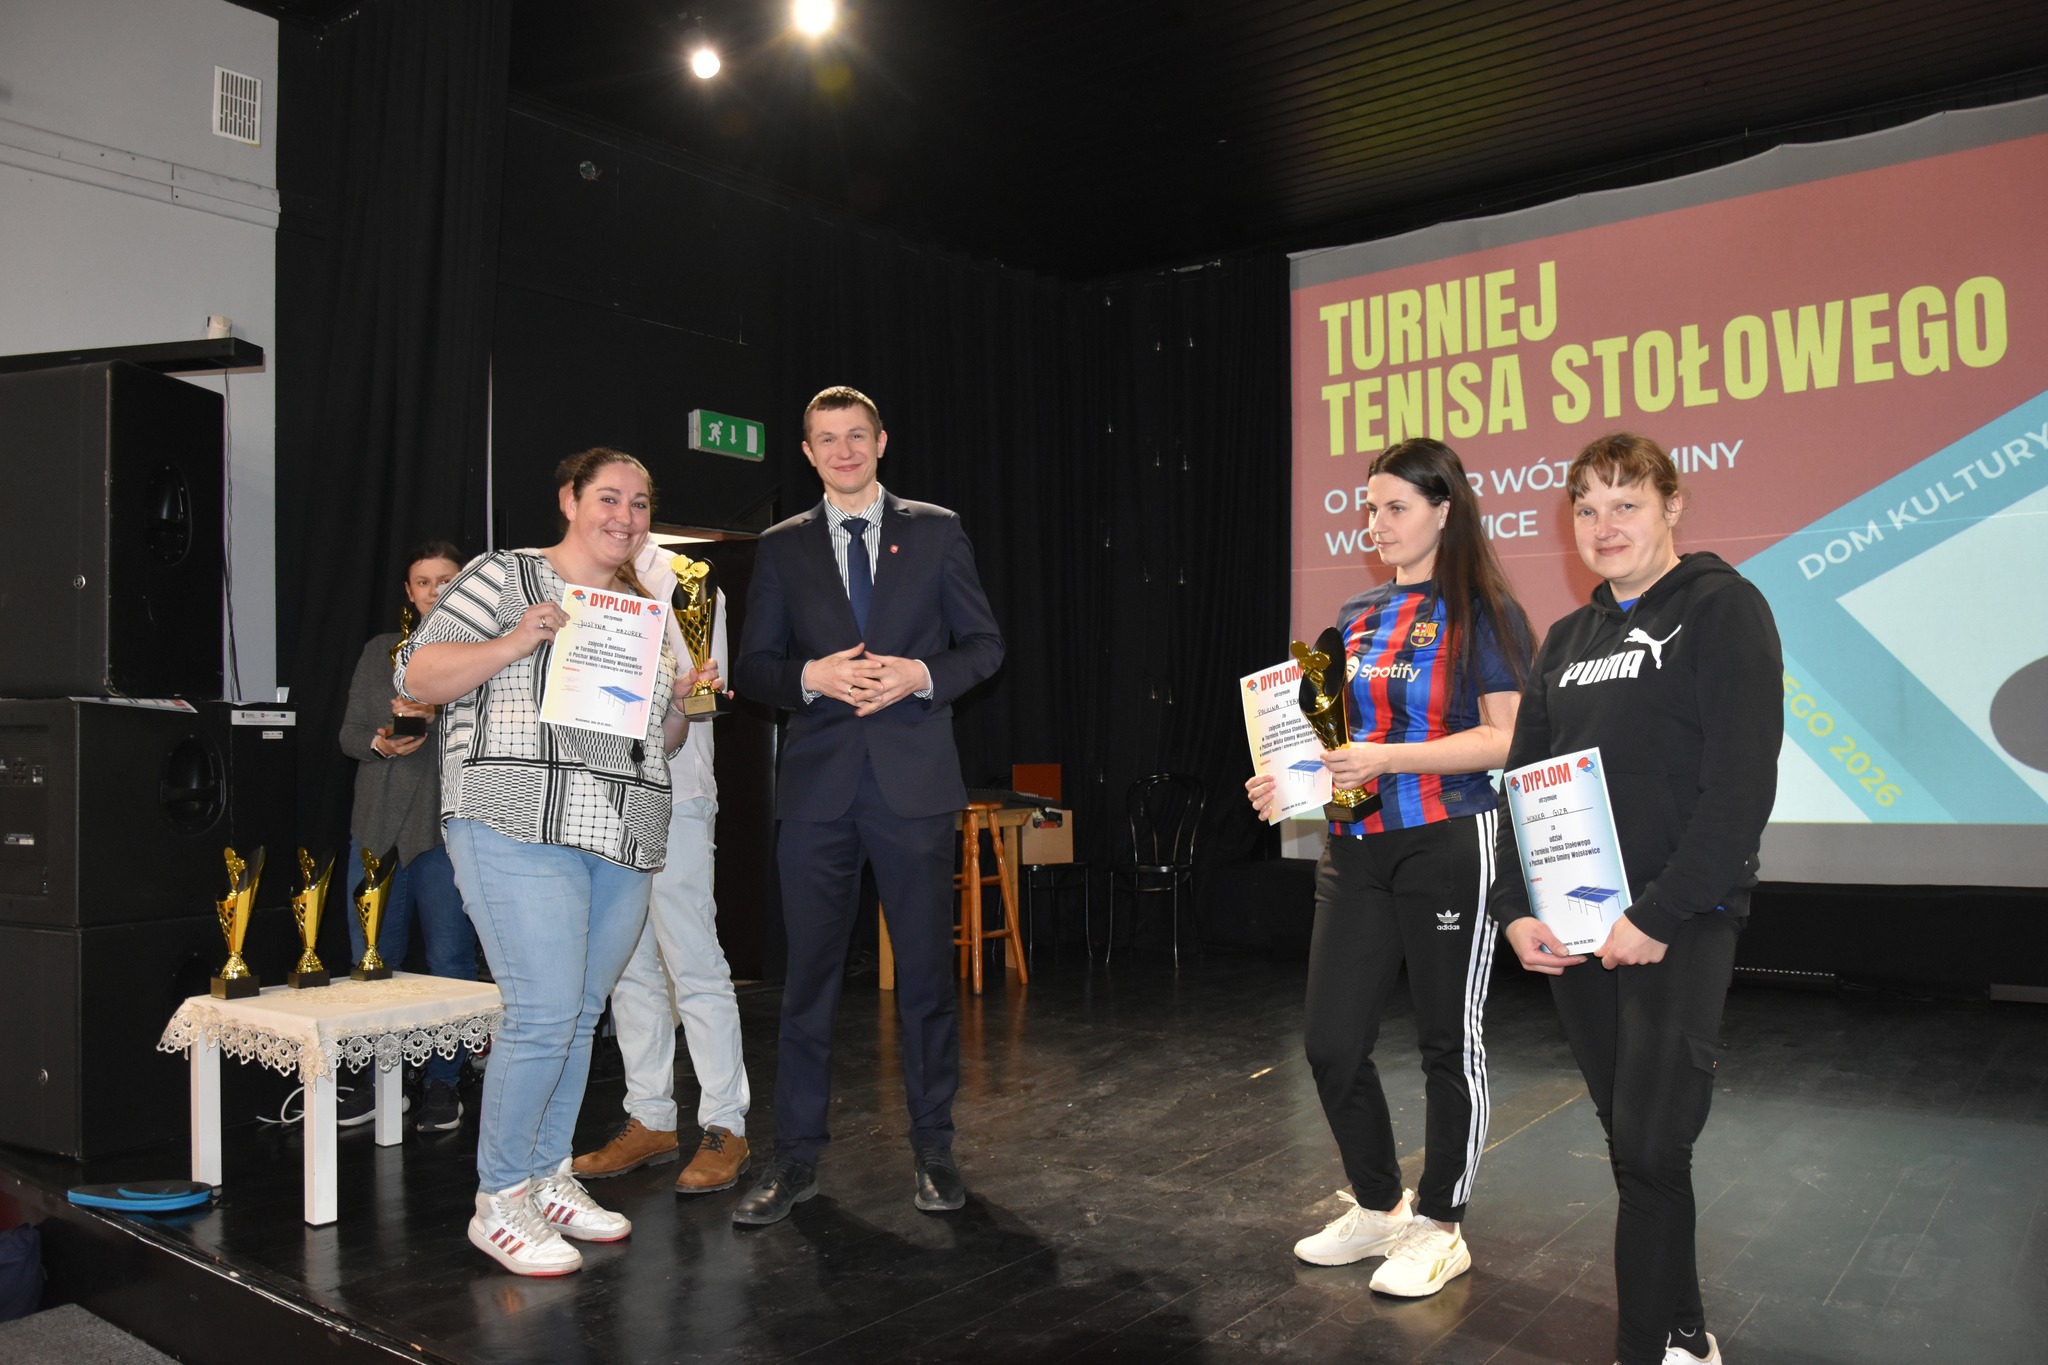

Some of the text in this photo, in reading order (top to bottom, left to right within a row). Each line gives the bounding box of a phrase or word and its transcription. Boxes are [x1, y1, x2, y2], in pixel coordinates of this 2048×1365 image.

[1320, 261, 1557, 376] TURNIEJ
[1321, 276, 2008, 456] TENISA STOŁOWEGO
[1324, 489, 1348, 515] O
[1490, 457, 1576, 495] WÓJ
[1797, 422, 2048, 581] DOM KULTURY
[590, 593, 642, 616] DYPLOM
[581, 646, 598, 654] Turnieju
[609, 644, 626, 652] miejsca
[1260, 666, 1304, 691] DYPLOM
[1359, 662, 1421, 683] Spotify
[1559, 650, 1645, 687] PUMA
[1286, 718, 1301, 726] miejsca
[1522, 763, 1572, 793] DYPLOM
[1829, 735, 1903, 807] 2026
[1539, 795, 1557, 803] otrzymuje
[1534, 848, 1549, 856] Turnieju
[1550, 844, 1564, 852] Tenisa
[1565, 839, 1591, 850] Stołowego
[1549, 834, 1562, 843] udział
[1556, 854, 1570, 862] Gminy
[1571, 847, 1601, 858] Wojsławice
